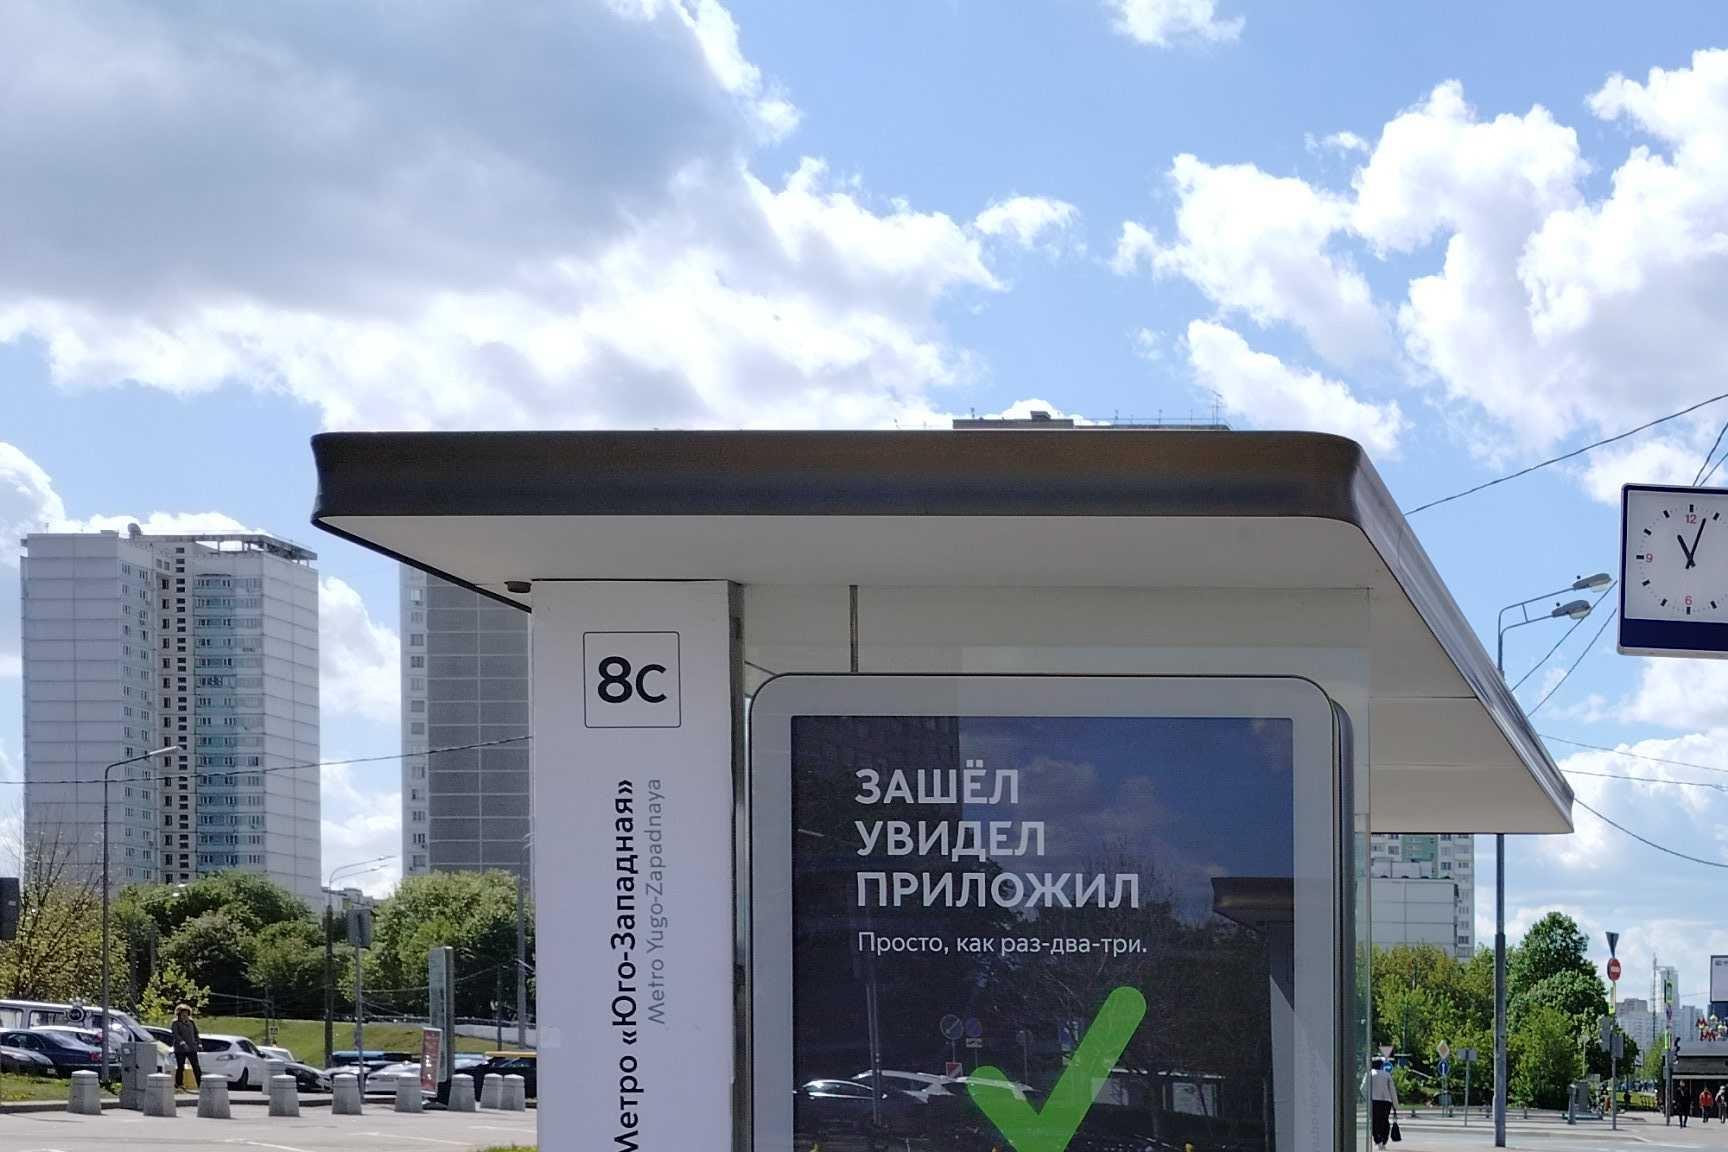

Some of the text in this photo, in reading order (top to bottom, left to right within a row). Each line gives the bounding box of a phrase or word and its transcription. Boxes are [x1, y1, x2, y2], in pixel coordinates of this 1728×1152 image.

[1685, 514, 1697, 524] 12
[1645, 553, 1653, 563] 9
[1684, 595, 1692, 605] 6
[855, 759, 1018, 804] ЗАШЁЛ
[854, 820, 1045, 862] УВИДЕЛ
[644, 778, 668, 1024] Metro Yugo-Zapadnaya
[856, 871, 1139, 908] ПРИЛОЖИЛ
[610, 779, 638, 1045] «Юго-Западная»
[858, 931, 1147, 957] Просто, как раз-два-три.
